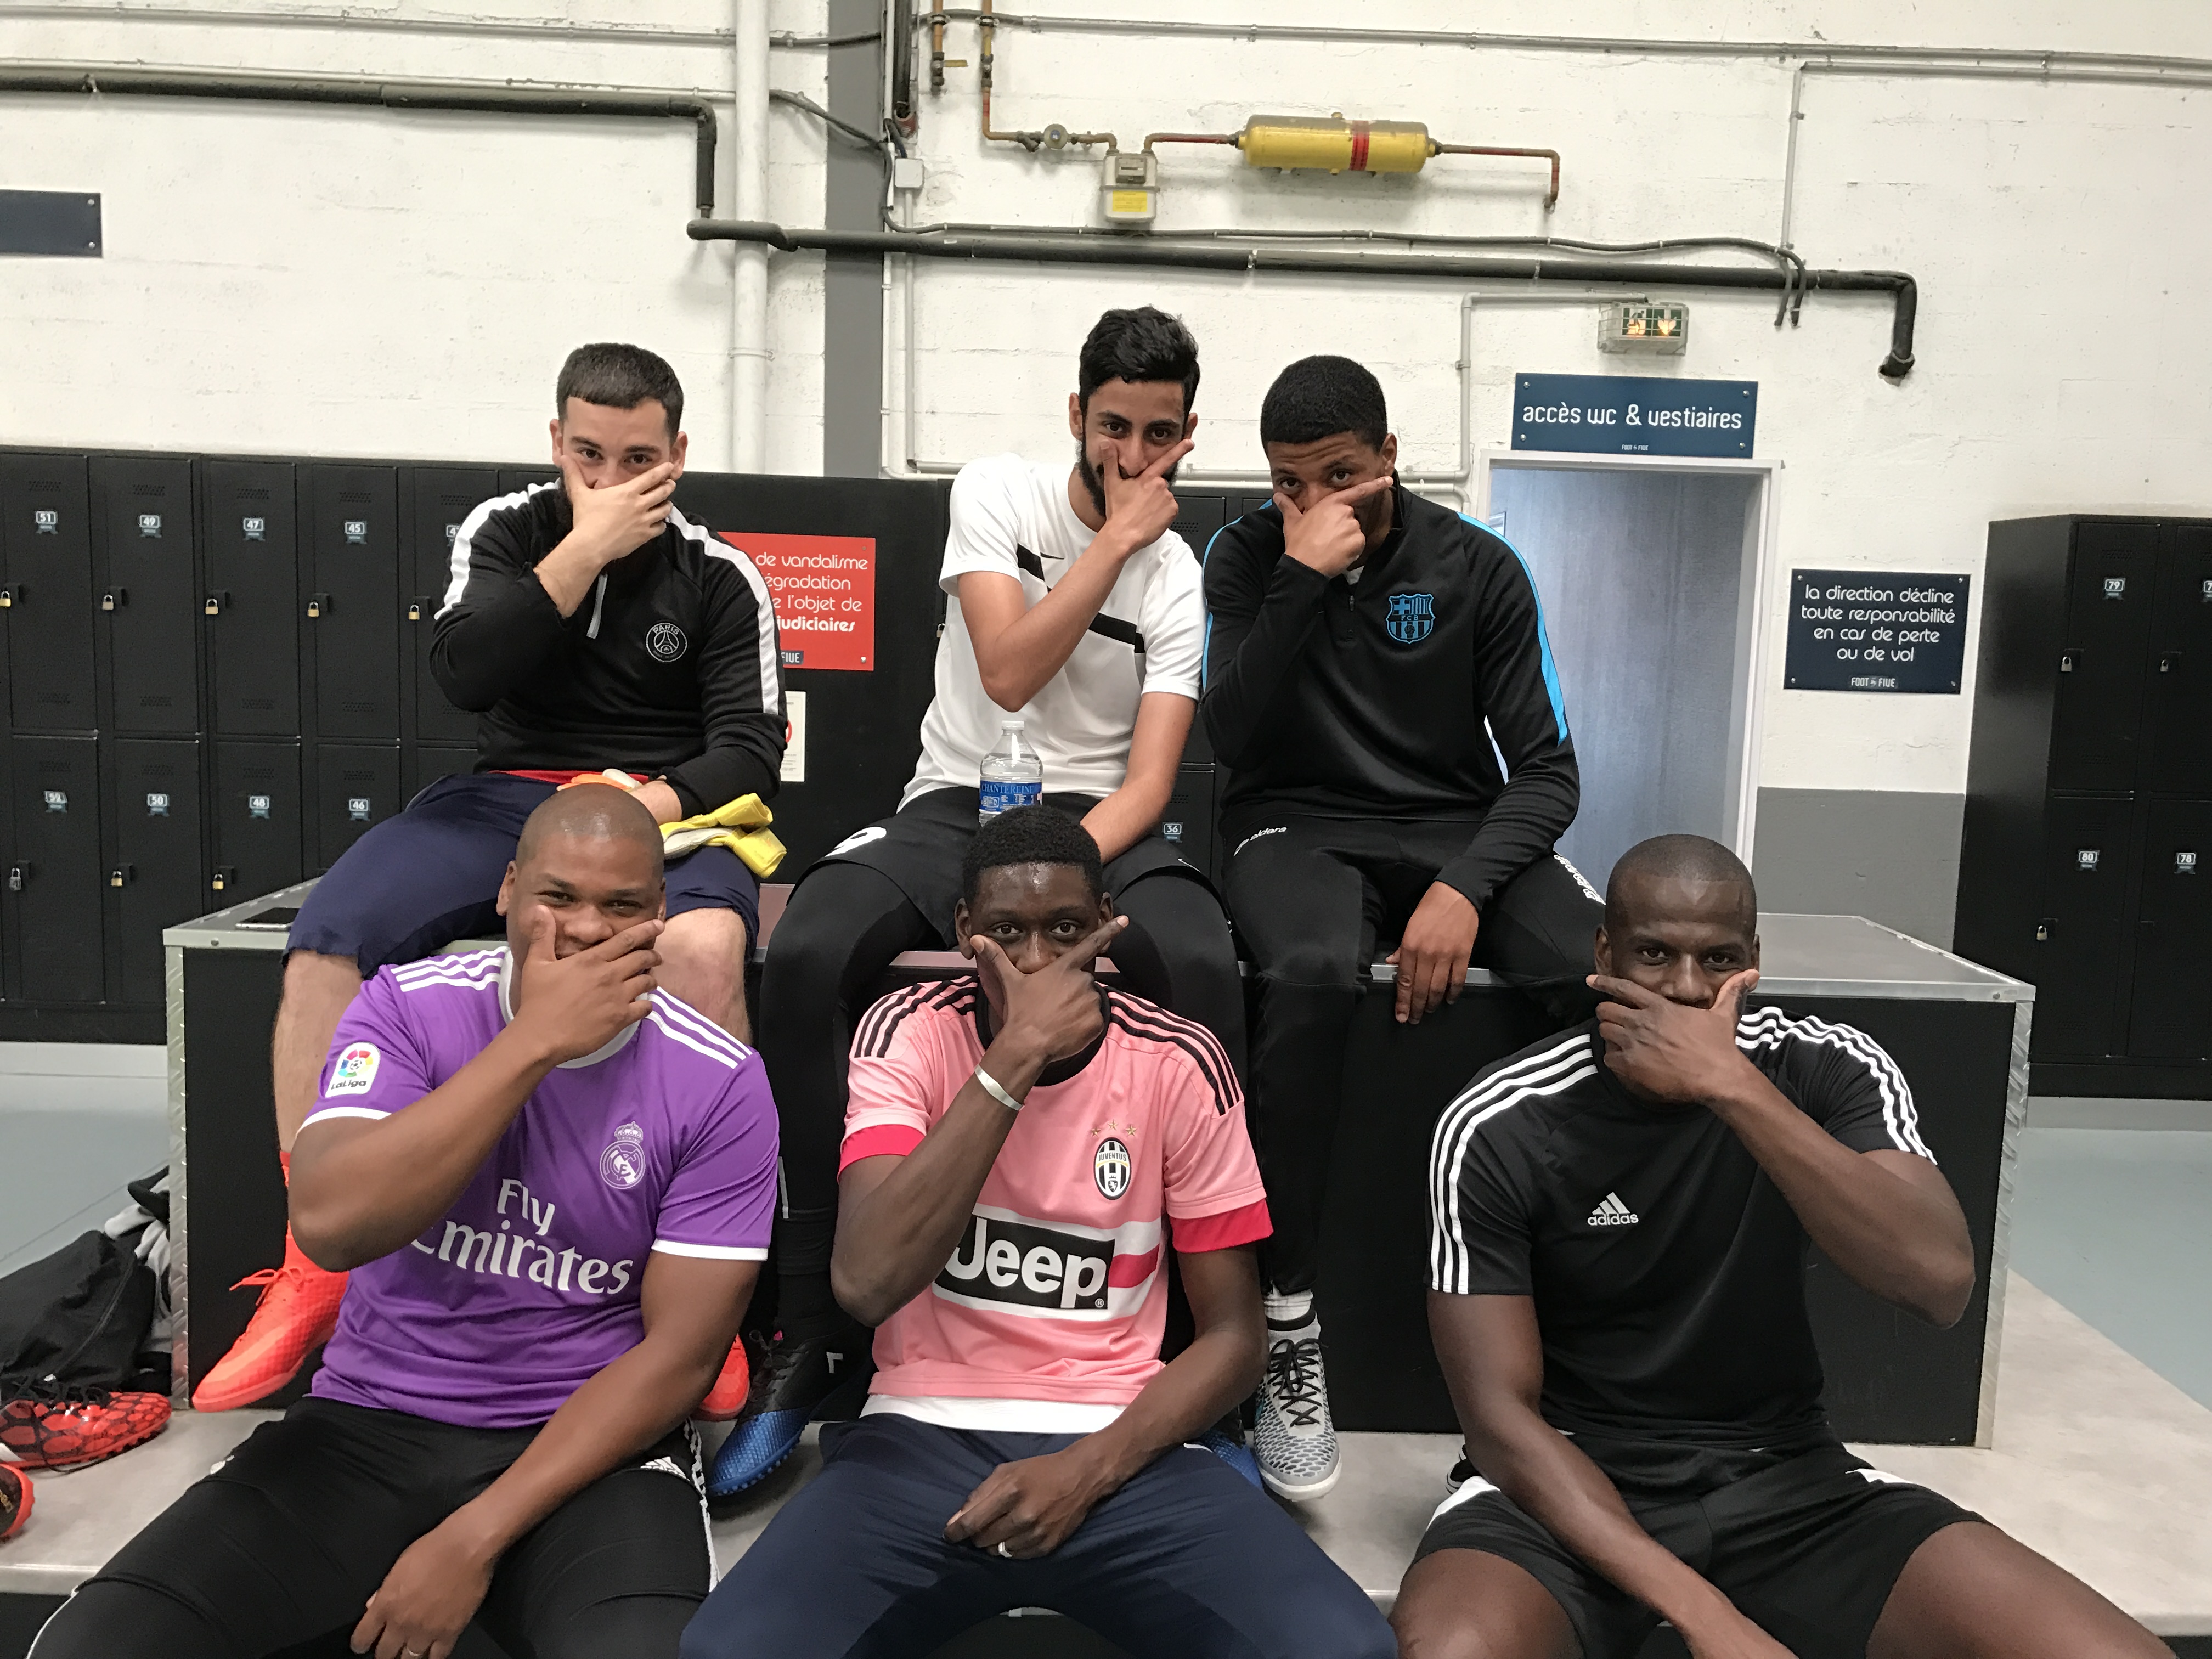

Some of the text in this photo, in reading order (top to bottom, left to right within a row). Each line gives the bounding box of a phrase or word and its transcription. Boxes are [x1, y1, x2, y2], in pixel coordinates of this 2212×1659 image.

[1523, 402, 1742, 429] accès wc & vestiaires
[40, 513, 50, 522] 51
[144, 517, 155, 526] 49
[247, 520, 259, 529] 47
[349, 524, 360, 532] 45
[755, 552, 868, 570] de vandalisme
[765, 573, 851, 591] égradation
[2109, 581, 2120, 589] 79
[1805, 584, 1954, 604] la direction décline
[788, 595, 835, 613] l'objet
[841, 598, 862, 612] de
[1801, 605, 1956, 624] toute responsabilité
[777, 615, 855, 632] judiciaires
[652, 624, 680, 635] PARIS
[1814, 626, 1940, 645] en cas de perte
[1837, 646, 1915, 662] ou de vol
[1851, 677, 1895, 687] FOOT FIVE
[981, 783, 1034, 794] CHANTEREINE
[151, 796, 163, 805] 50
[253, 799, 265, 807] 48
[353, 801, 364, 809] 46
[2082, 853, 2094, 861] 80
[2181, 855, 2191, 863] 78
[331, 1079, 367, 1090] LaLiga
[1098, 1152, 1127, 1161] JUVENTUS
[496, 1178, 555, 1236] Fly
[1587, 1213, 1639, 1226] adidas
[945, 1217, 1107, 1308] Jeep
